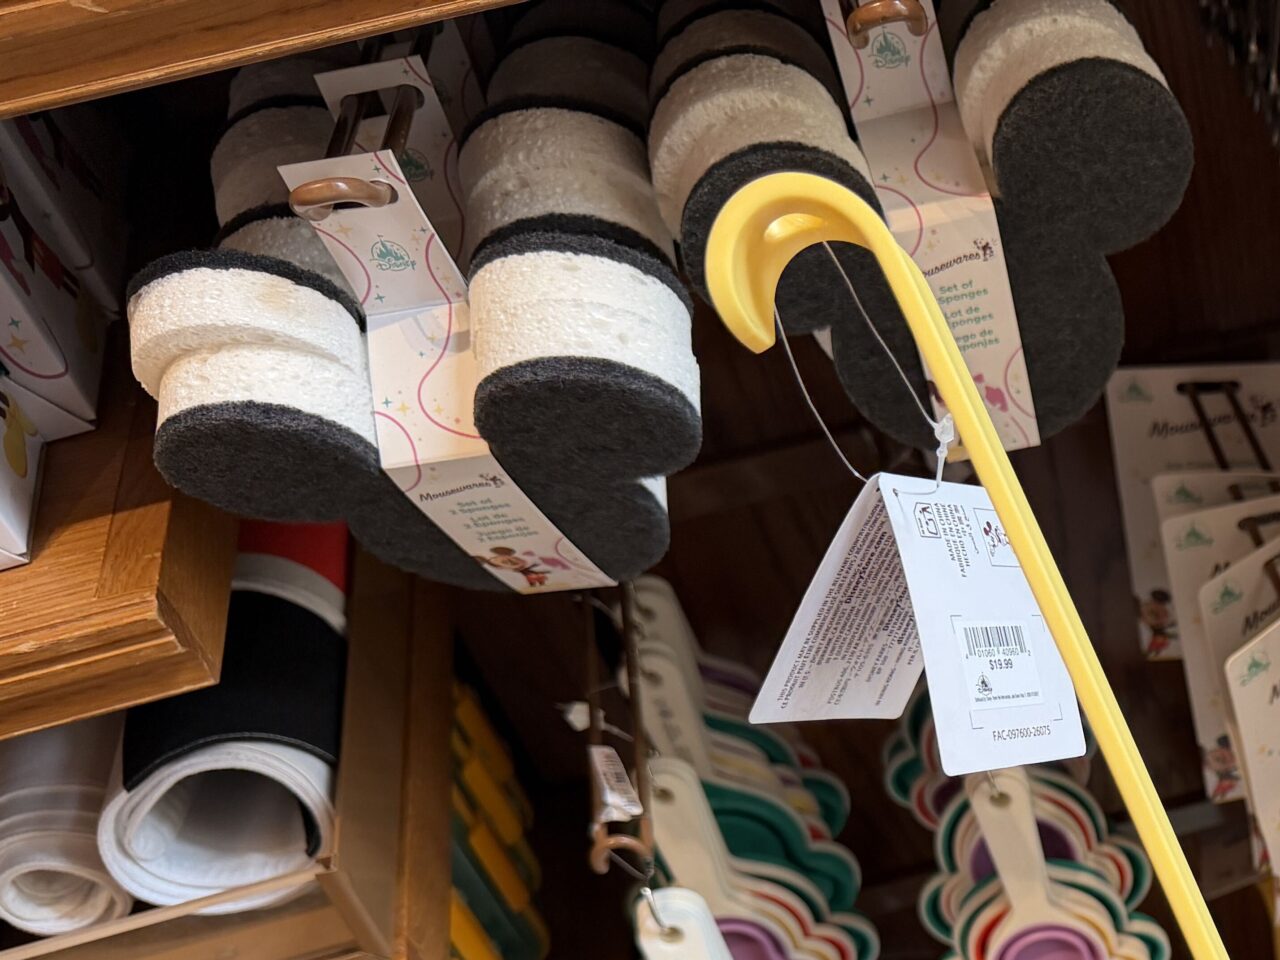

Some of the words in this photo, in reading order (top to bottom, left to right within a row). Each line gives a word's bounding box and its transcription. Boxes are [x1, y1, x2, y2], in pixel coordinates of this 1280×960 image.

[938, 288, 989, 305] Sponges
[939, 284, 958, 295] Set
[961, 280, 974, 290] of
[945, 309, 963, 320] Lot
[966, 306, 981, 315] de
[979, 328, 994, 338] de
[933, 502, 945, 525] CHINA
[939, 503, 951, 525] CHINE
[946, 503, 958, 526] CHINA
[944, 537, 956, 560] MADE
[957, 540, 970, 566] HECHO
[843, 531, 888, 603] DisneyStore.com
[989, 658, 1014, 670] $19.99
[992, 725, 1051, 741] FAC-097600-26075
